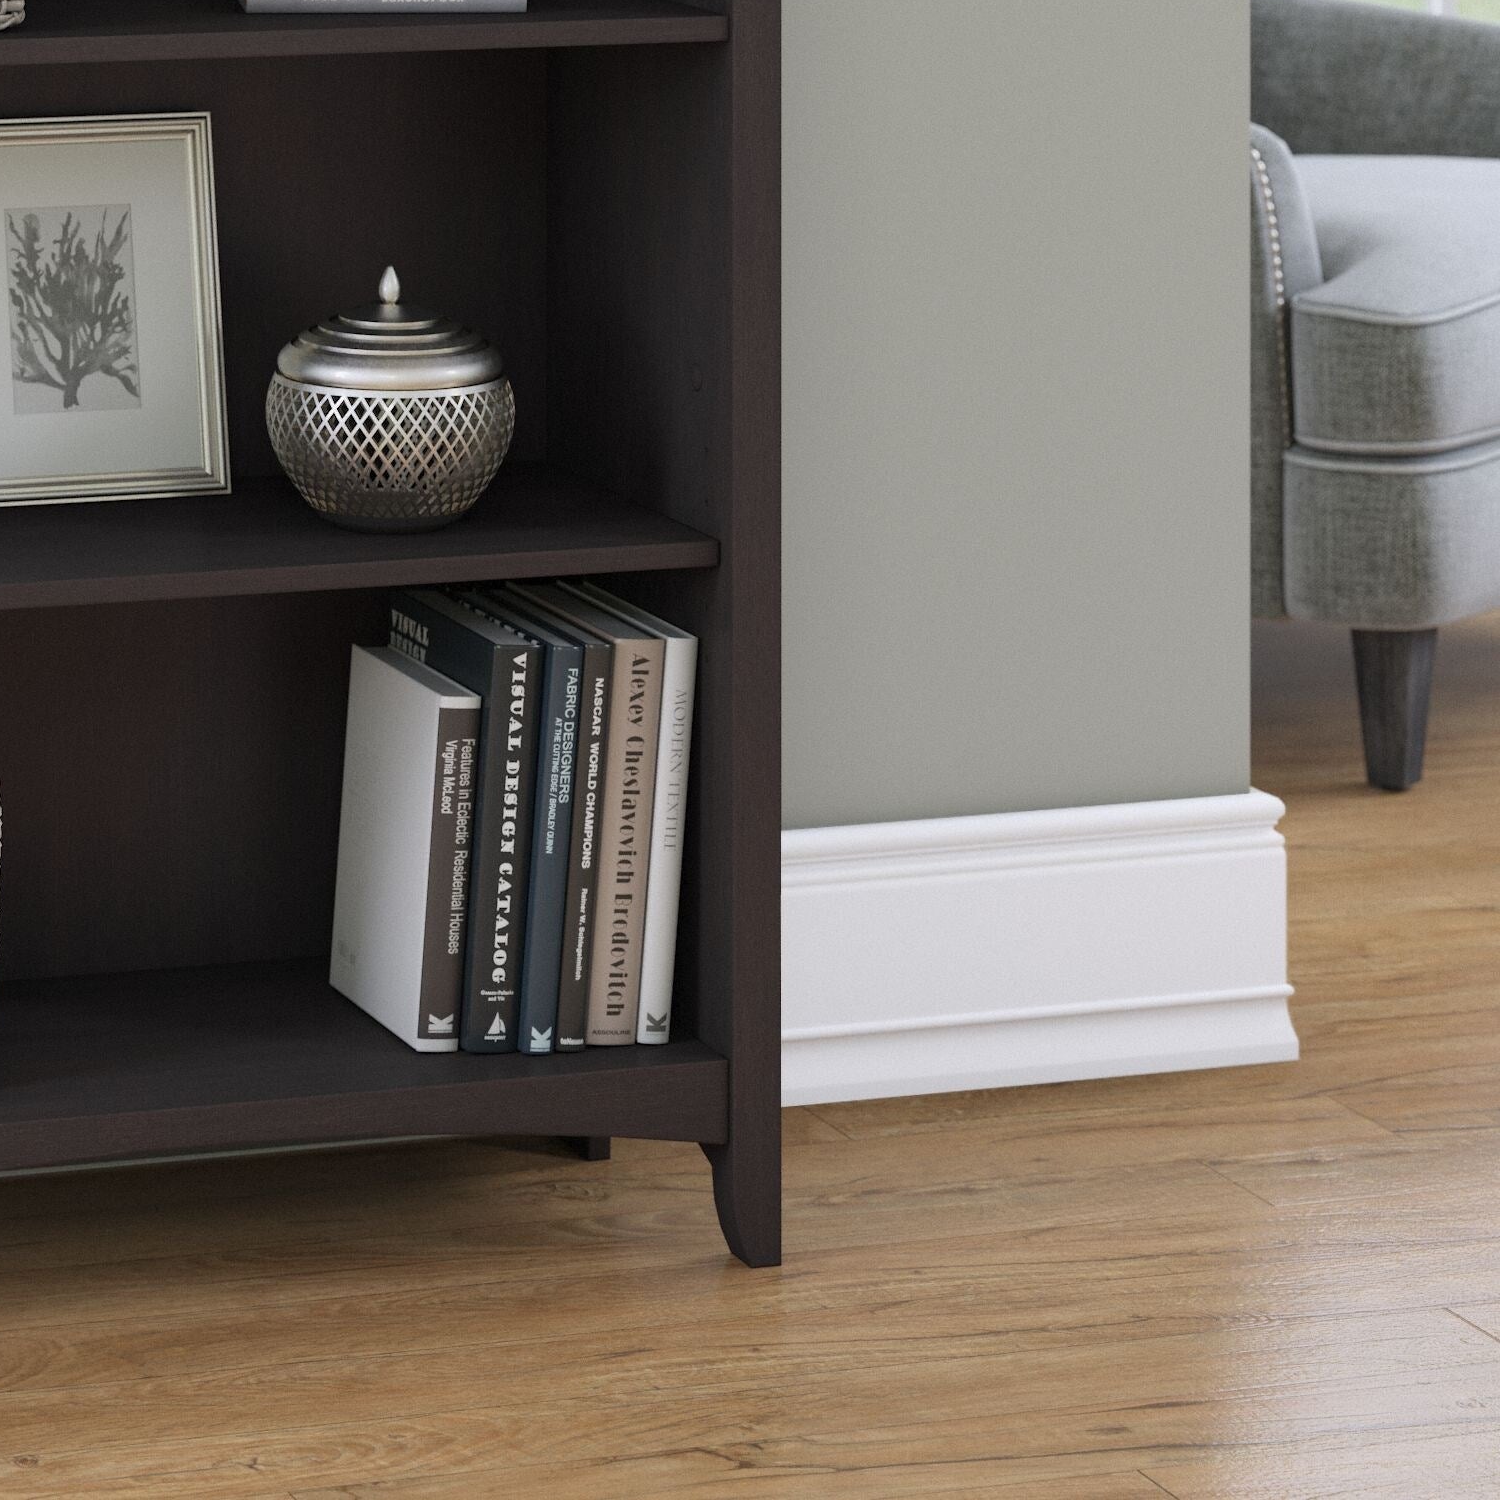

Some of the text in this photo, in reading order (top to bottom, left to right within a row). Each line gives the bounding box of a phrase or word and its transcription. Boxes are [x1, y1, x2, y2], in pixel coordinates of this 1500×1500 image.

[391, 609, 429, 648] VISUAL
[507, 652, 527, 751] VISUAL
[555, 717, 562, 726] AT
[558, 668, 579, 803] FABRIC DESIGNERS
[591, 678, 604, 736] NASCAR
[441, 740, 457, 814] Virginia McLeod
[549, 774, 558, 792] EDGE
[552, 744, 560, 772] CUTTING
[587, 742, 599, 790] WORLD
[663, 689, 688, 852] MODERN TEXTILE
[500, 759, 520, 855] DESIGN
[547, 798, 557, 829] BRADLEY
[581, 792, 596, 869] CHAMPIONS
[606, 653, 650, 1017] Alexey Cheslavovich Brodovitch
[448, 738, 475, 954] Features in Eclectic Residential Houses
[492, 862, 513, 983] CATALOG
